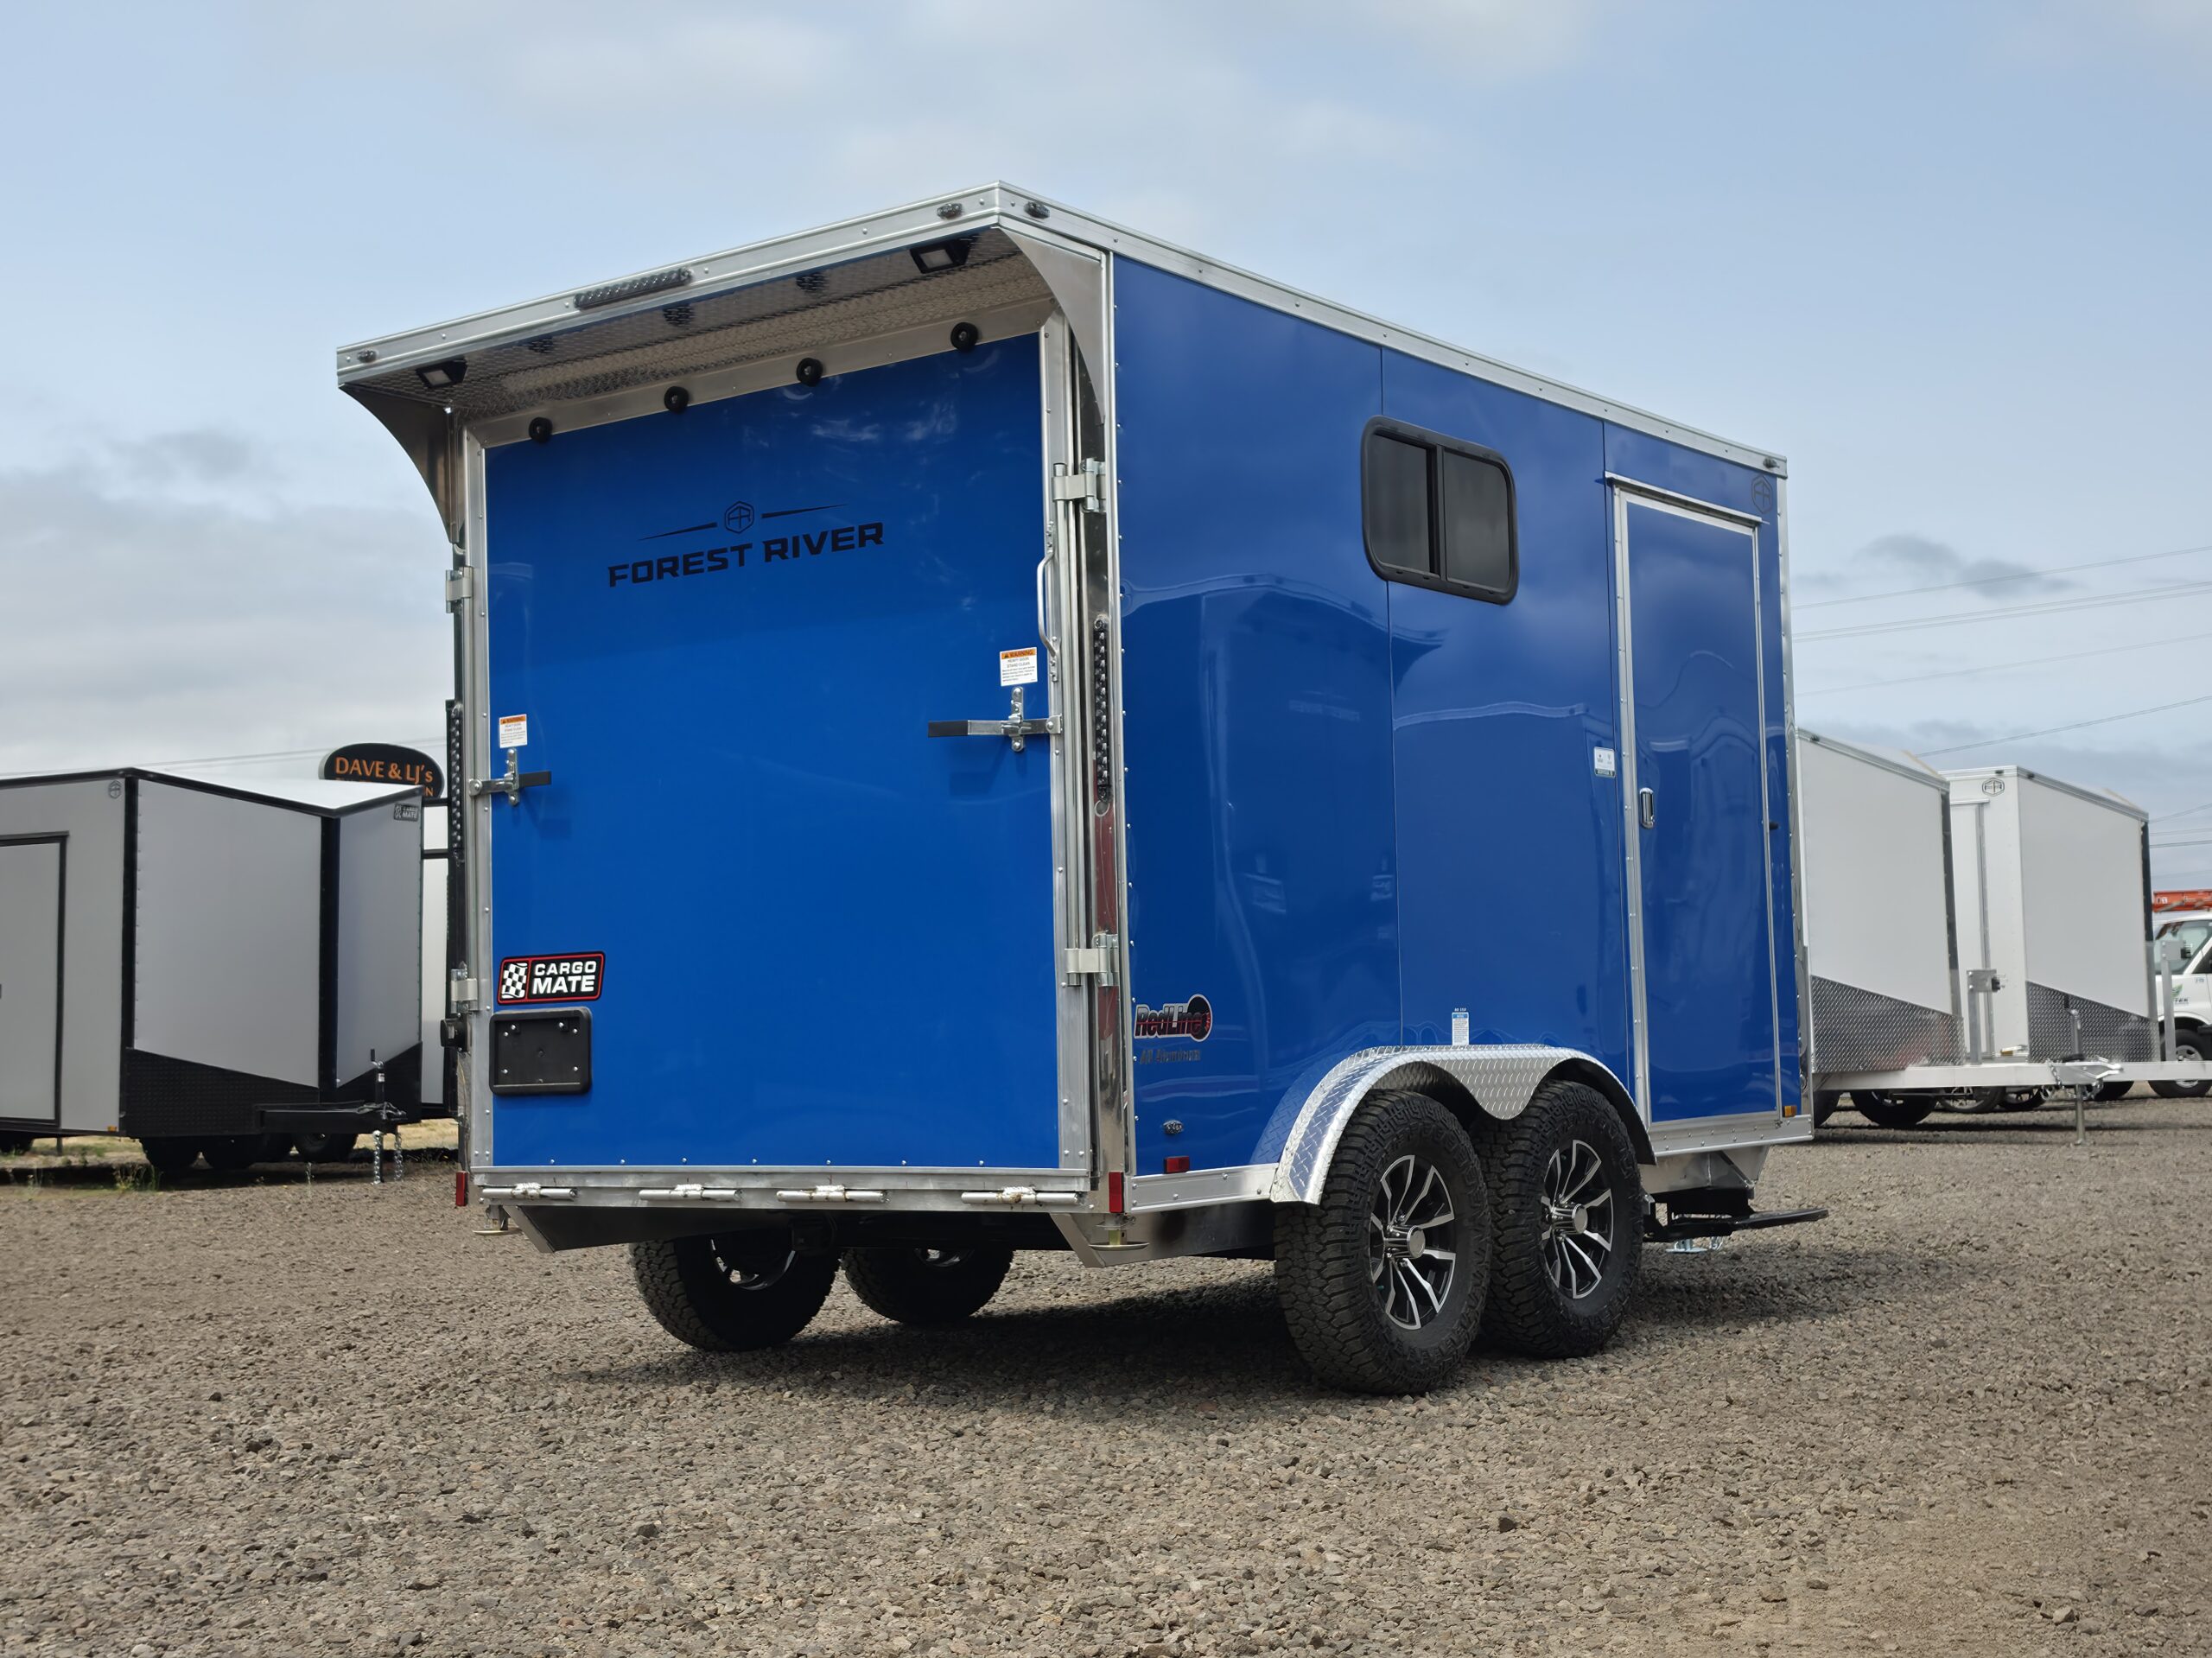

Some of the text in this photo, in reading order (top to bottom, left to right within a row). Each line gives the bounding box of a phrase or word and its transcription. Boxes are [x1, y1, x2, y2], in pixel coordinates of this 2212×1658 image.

[607, 521, 885, 588] FOREST RIVER
[335, 756, 385, 778] DAVE
[388, 762, 403, 780] &
[534, 961, 597, 976] CARGO
[532, 975, 596, 995] MATE
